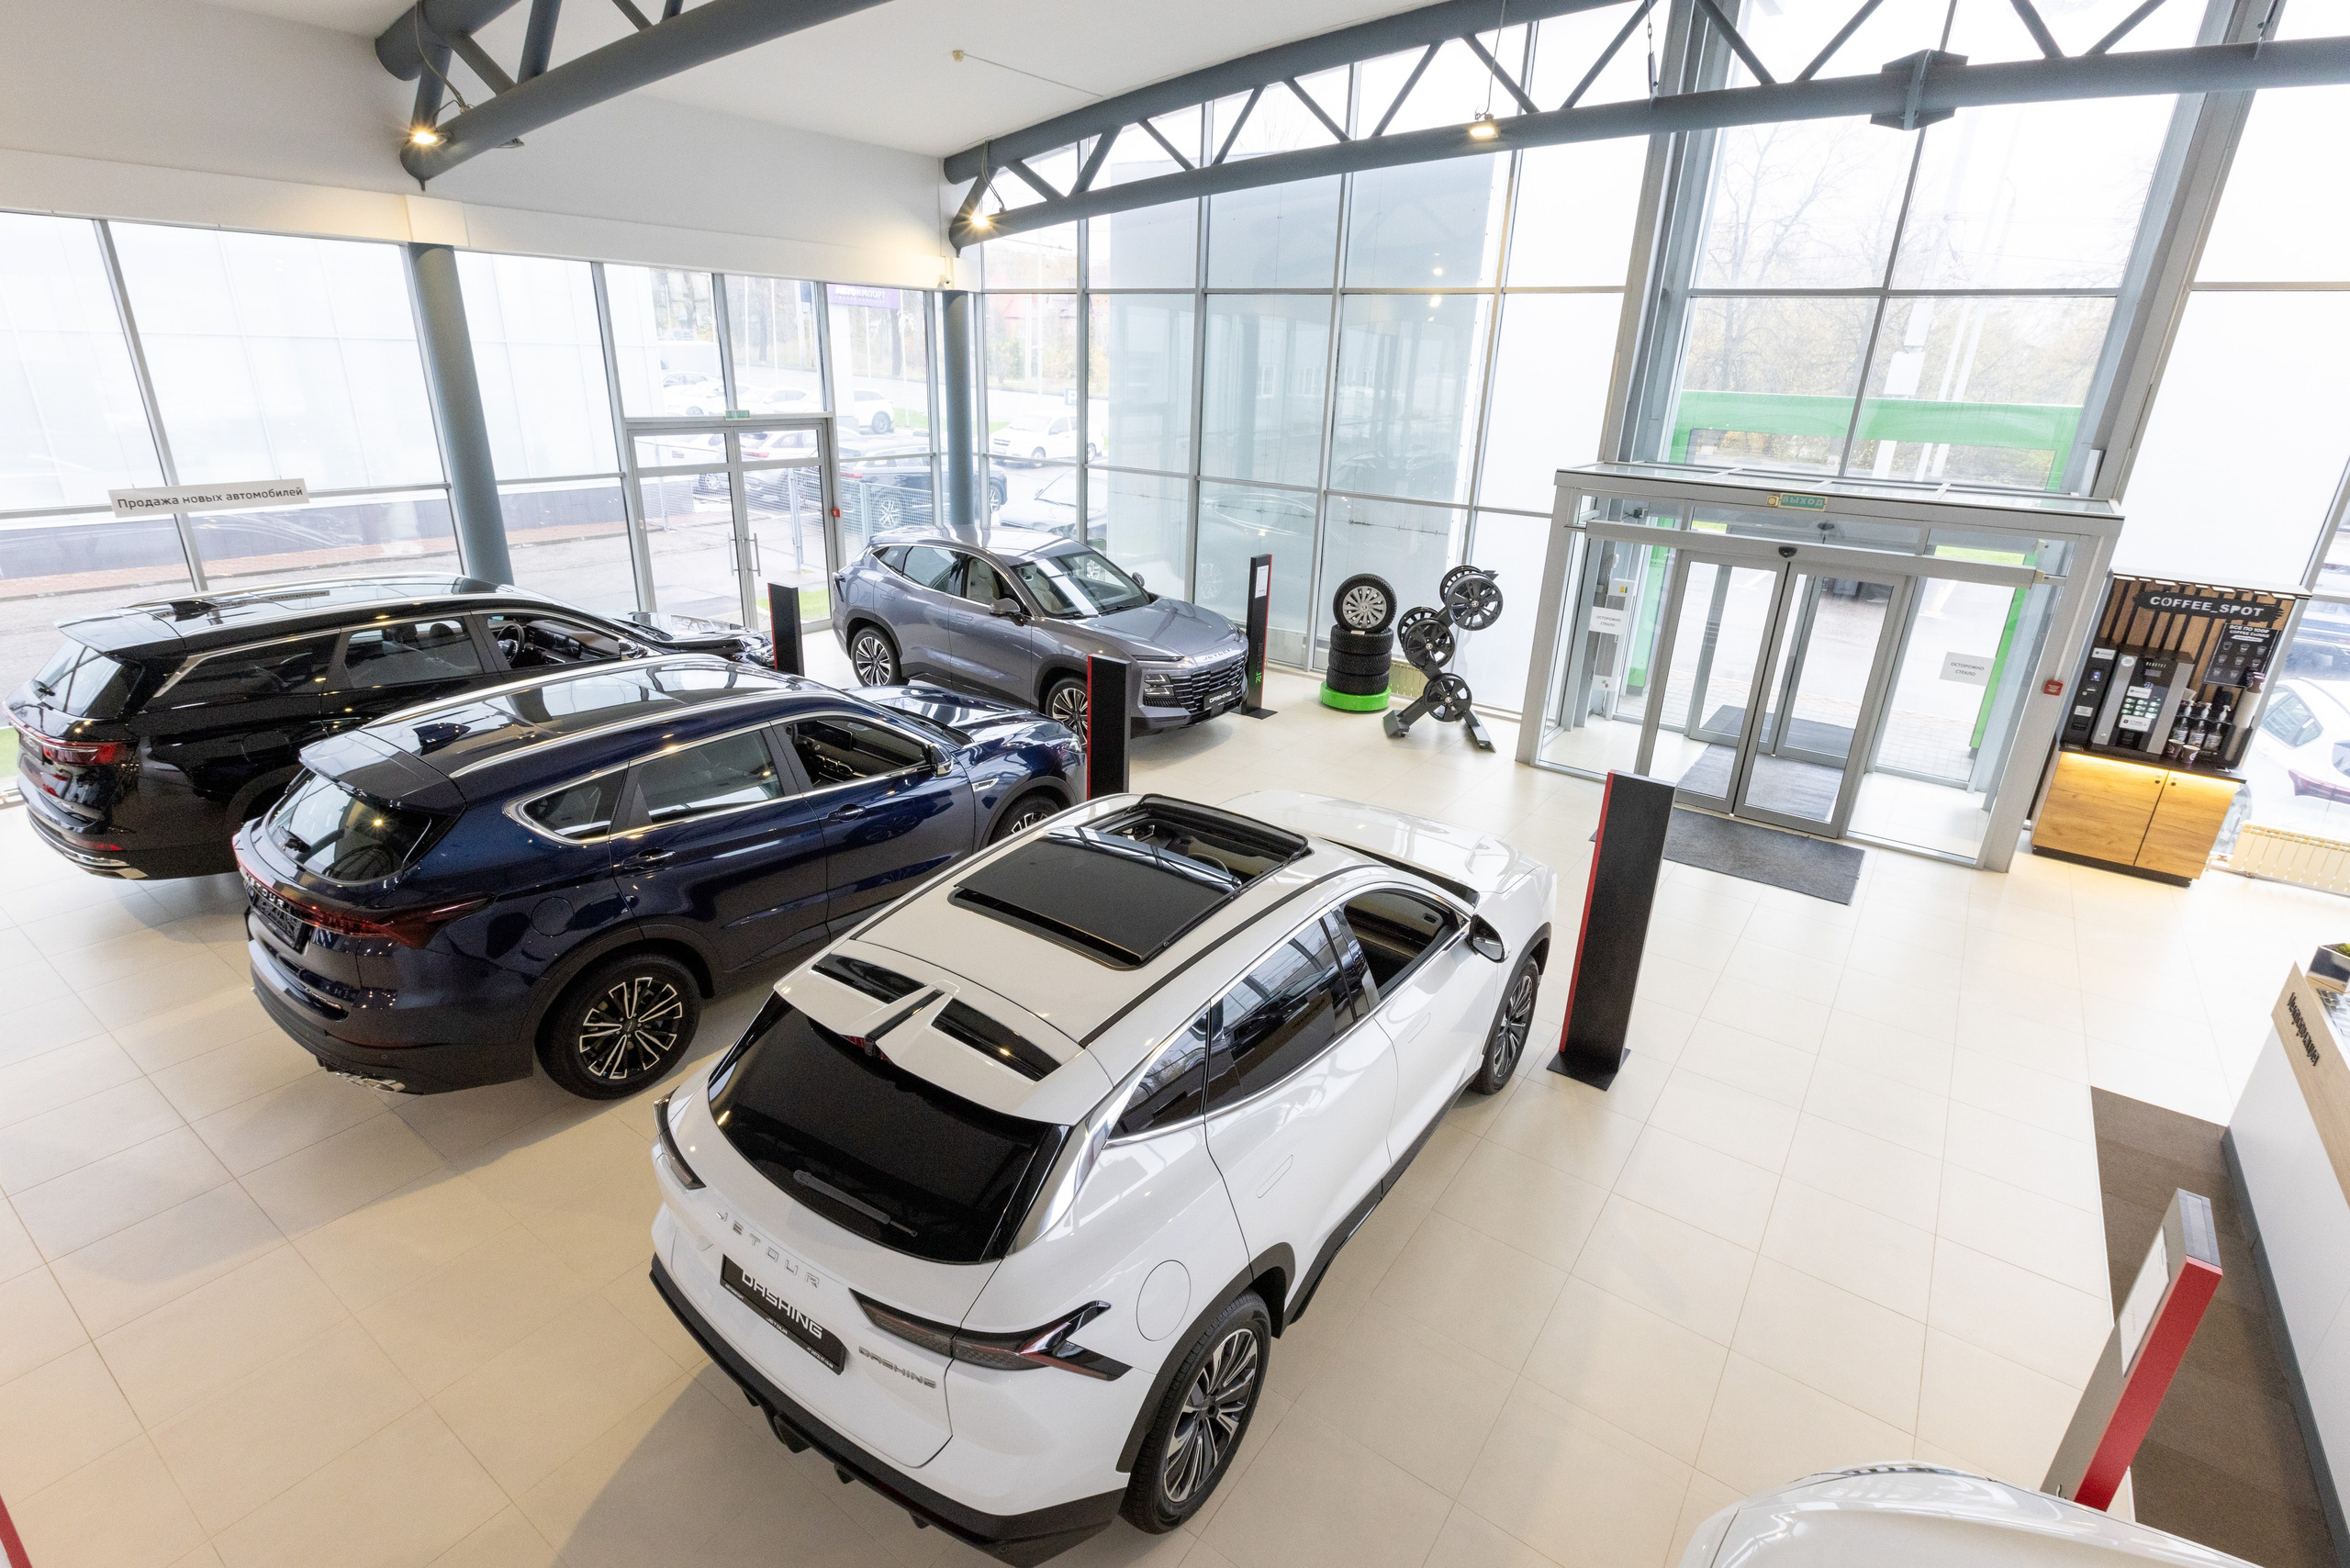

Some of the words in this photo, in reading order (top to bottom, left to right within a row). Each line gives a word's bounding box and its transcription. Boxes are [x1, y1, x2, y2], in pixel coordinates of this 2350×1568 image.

[118, 496, 179, 510] Продажа
[182, 494, 222, 504] новых
[226, 487, 303, 501] автомобилей
[1782, 496, 1824, 508] ВЫХОД
[1951, 662, 1985, 671] ОСТОРОЖНО
[716, 1212, 820, 1288] JETOUR
[742, 1270, 822, 1339] DASHING
[767, 1316, 789, 1335] JETOUR
[858, 1345, 936, 1390] DASHING
